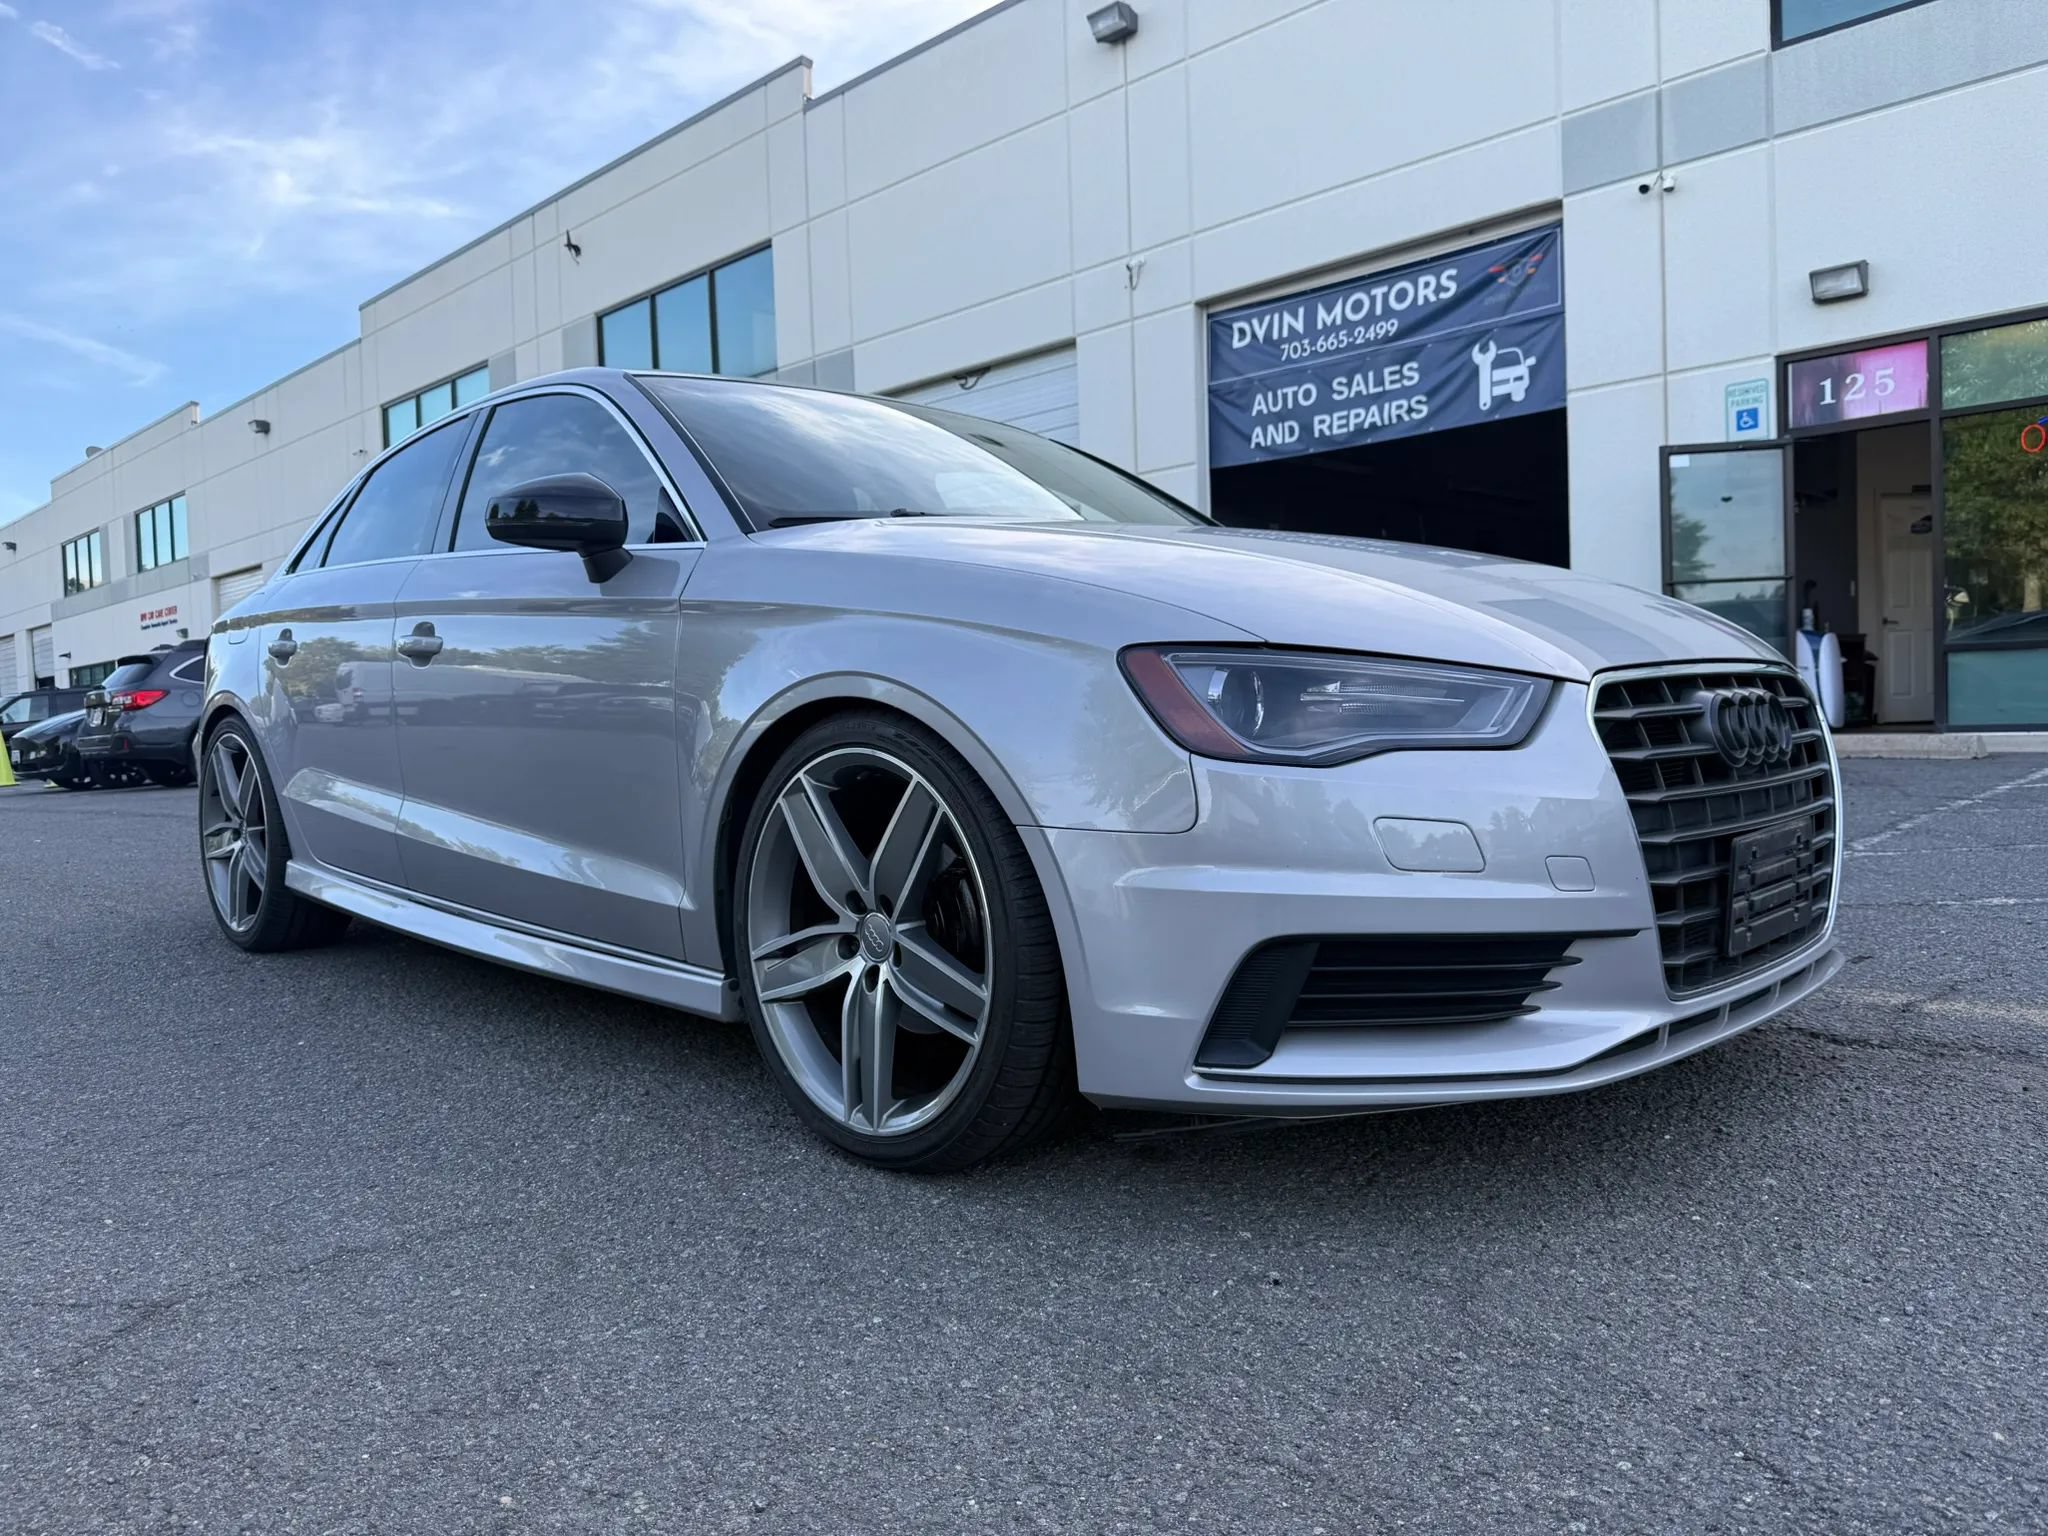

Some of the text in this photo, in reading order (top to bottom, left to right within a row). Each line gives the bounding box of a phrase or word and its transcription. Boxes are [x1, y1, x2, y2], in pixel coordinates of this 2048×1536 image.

[1231, 307, 1304, 349] DVIN
[1316, 268, 1458, 331] MOTORS
[1280, 318, 1398, 361] 703-665-2499
[1251, 361, 1420, 416] AUTO SALES
[1819, 367, 1896, 405] 125
[1250, 394, 1429, 449] AND REPAIRS
